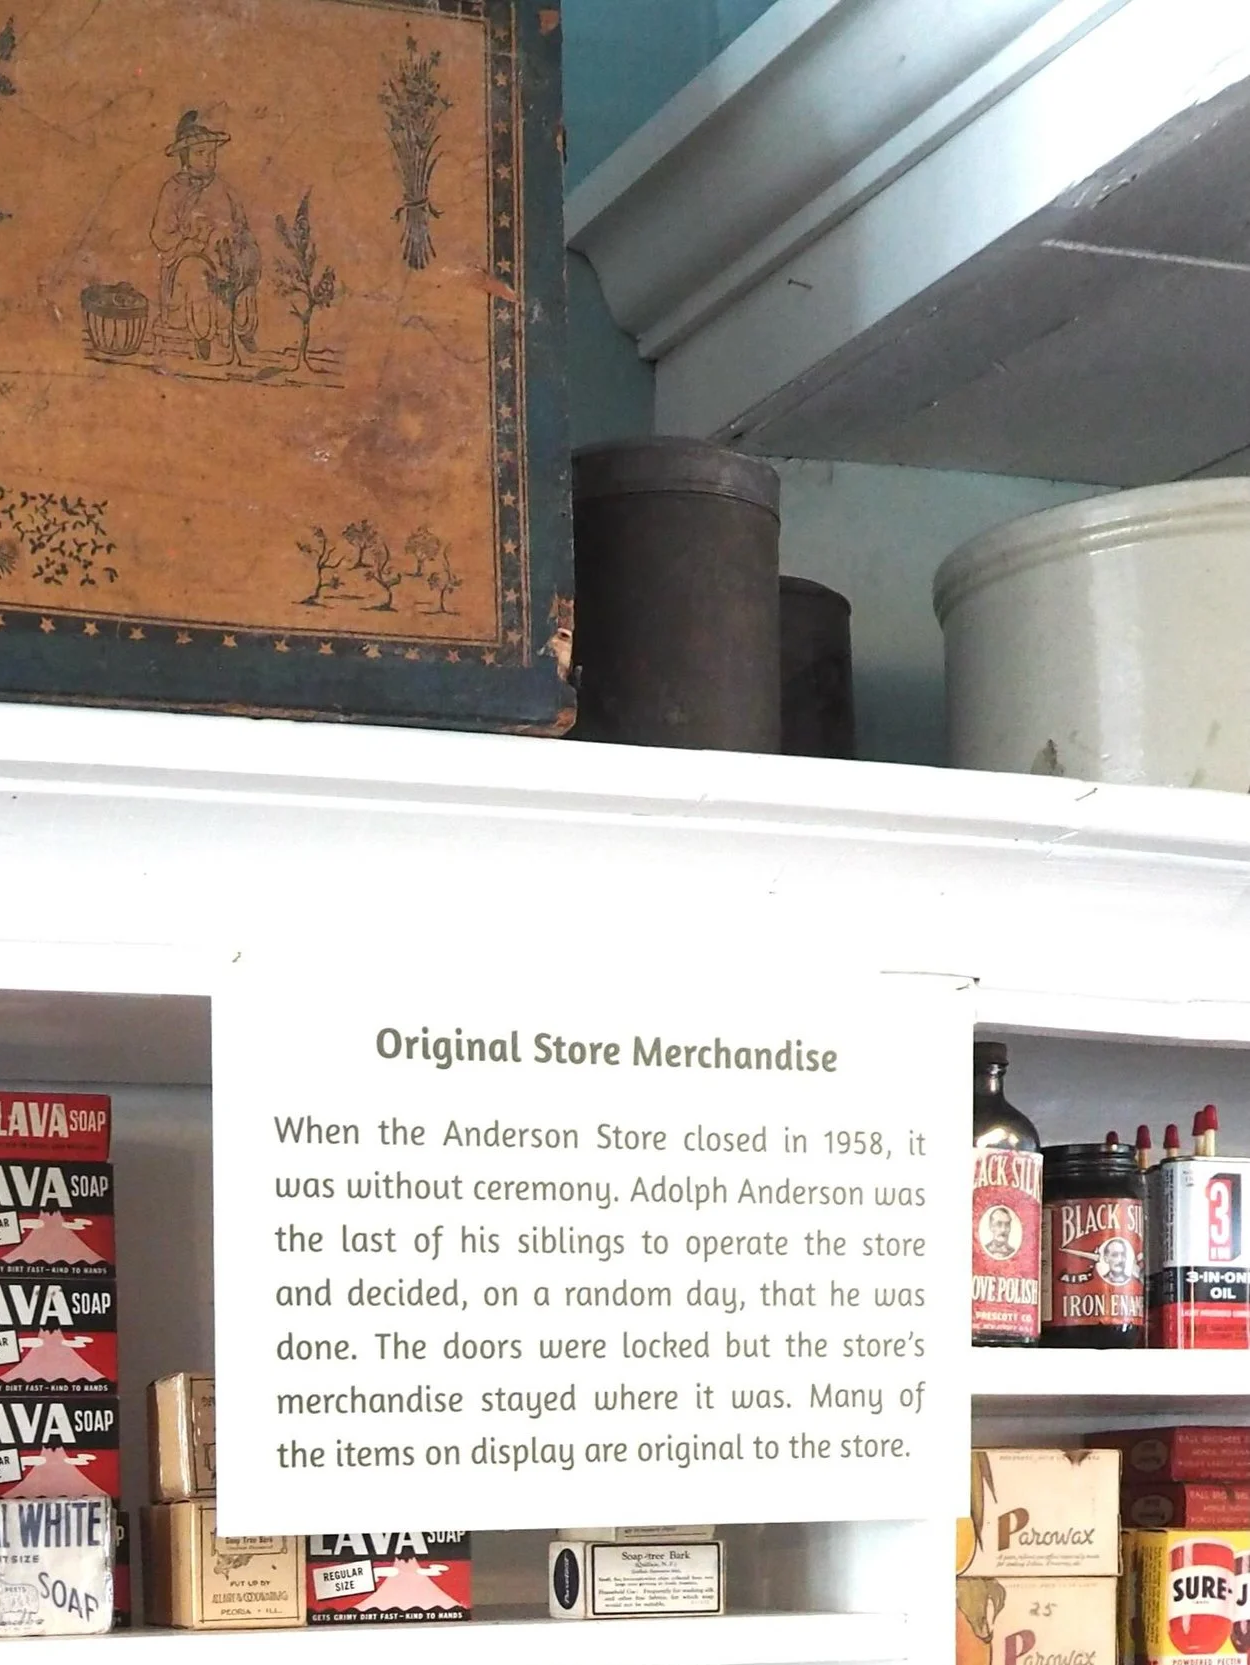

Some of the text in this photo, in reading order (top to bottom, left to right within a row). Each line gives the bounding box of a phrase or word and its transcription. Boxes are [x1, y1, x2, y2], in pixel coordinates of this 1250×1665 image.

[375, 1026, 838, 1073] Original Store Merchandise
[273, 1114, 926, 1160] When the Anderson Store closed in 1958, it
[71, 1176, 108, 1196] SOAP
[275, 1170, 926, 1211] was without ceremony. Adolph Anderson was
[274, 1223, 926, 1263] the last of his siblings to operate the store
[1061, 1205, 1119, 1248] BLACK
[275, 1277, 925, 1315] and decided, on a random day, that he was
[1063, 1295, 1107, 1317] IRON
[1210, 1288, 1236, 1299] OIL
[276, 1330, 925, 1361] done. The doors were locked but the store's
[276, 1380, 926, 1420] merchandise stayed where it was. Many of
[276, 1431, 911, 1472] the items on display are original to the store.
[18, 1502, 100, 1547] WHITE
[998, 1508, 1094, 1551] Parowax
